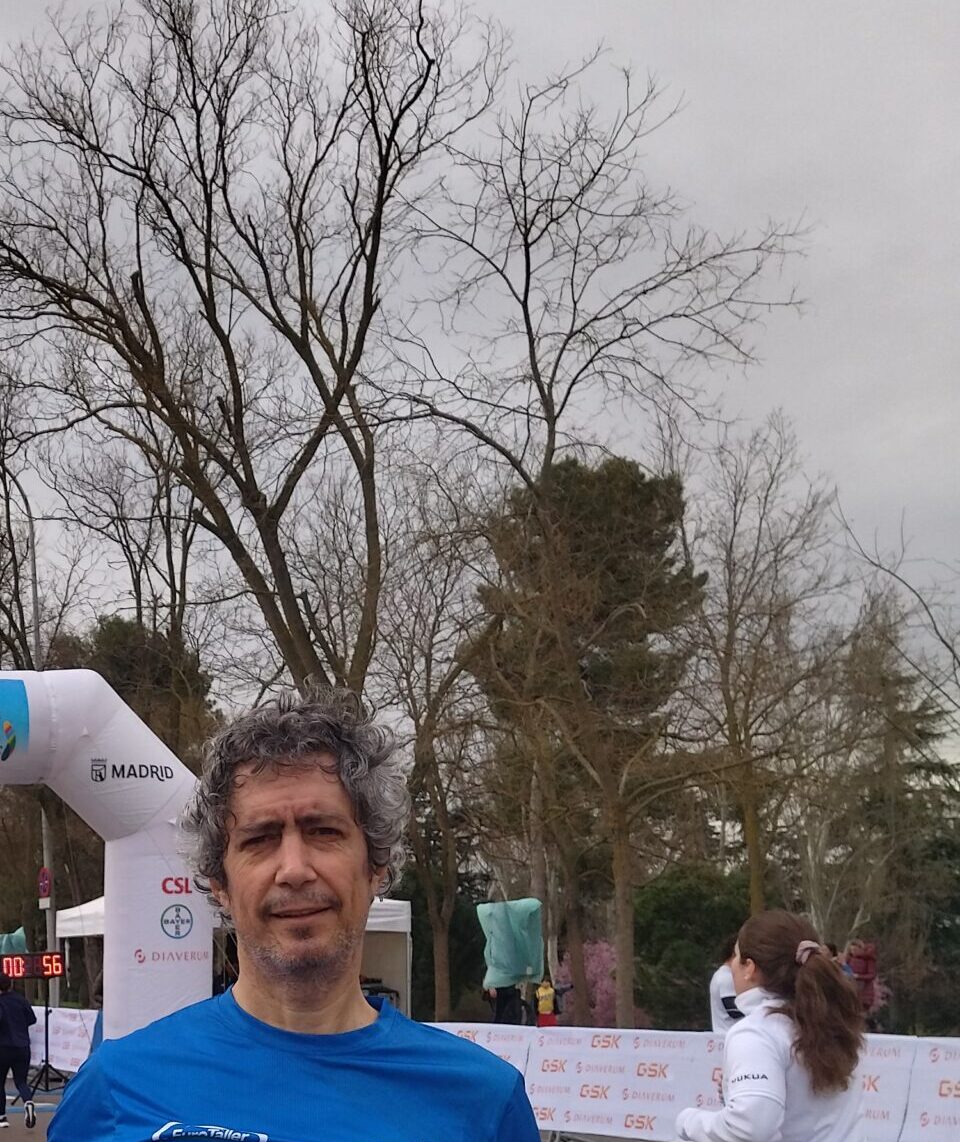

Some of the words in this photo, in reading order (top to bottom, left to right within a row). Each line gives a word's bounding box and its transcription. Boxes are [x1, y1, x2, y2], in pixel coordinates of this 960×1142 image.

[111, 763, 174, 782] MADRID
[162, 877, 193, 894] CSL
[42, 954, 62, 976] 56
[591, 1034, 621, 1049] GSK
[541, 1059, 567, 1073] GSK
[636, 1063, 669, 1079] GSK
[580, 1084, 610, 1100] GSK
[624, 1114, 657, 1131] GSK
